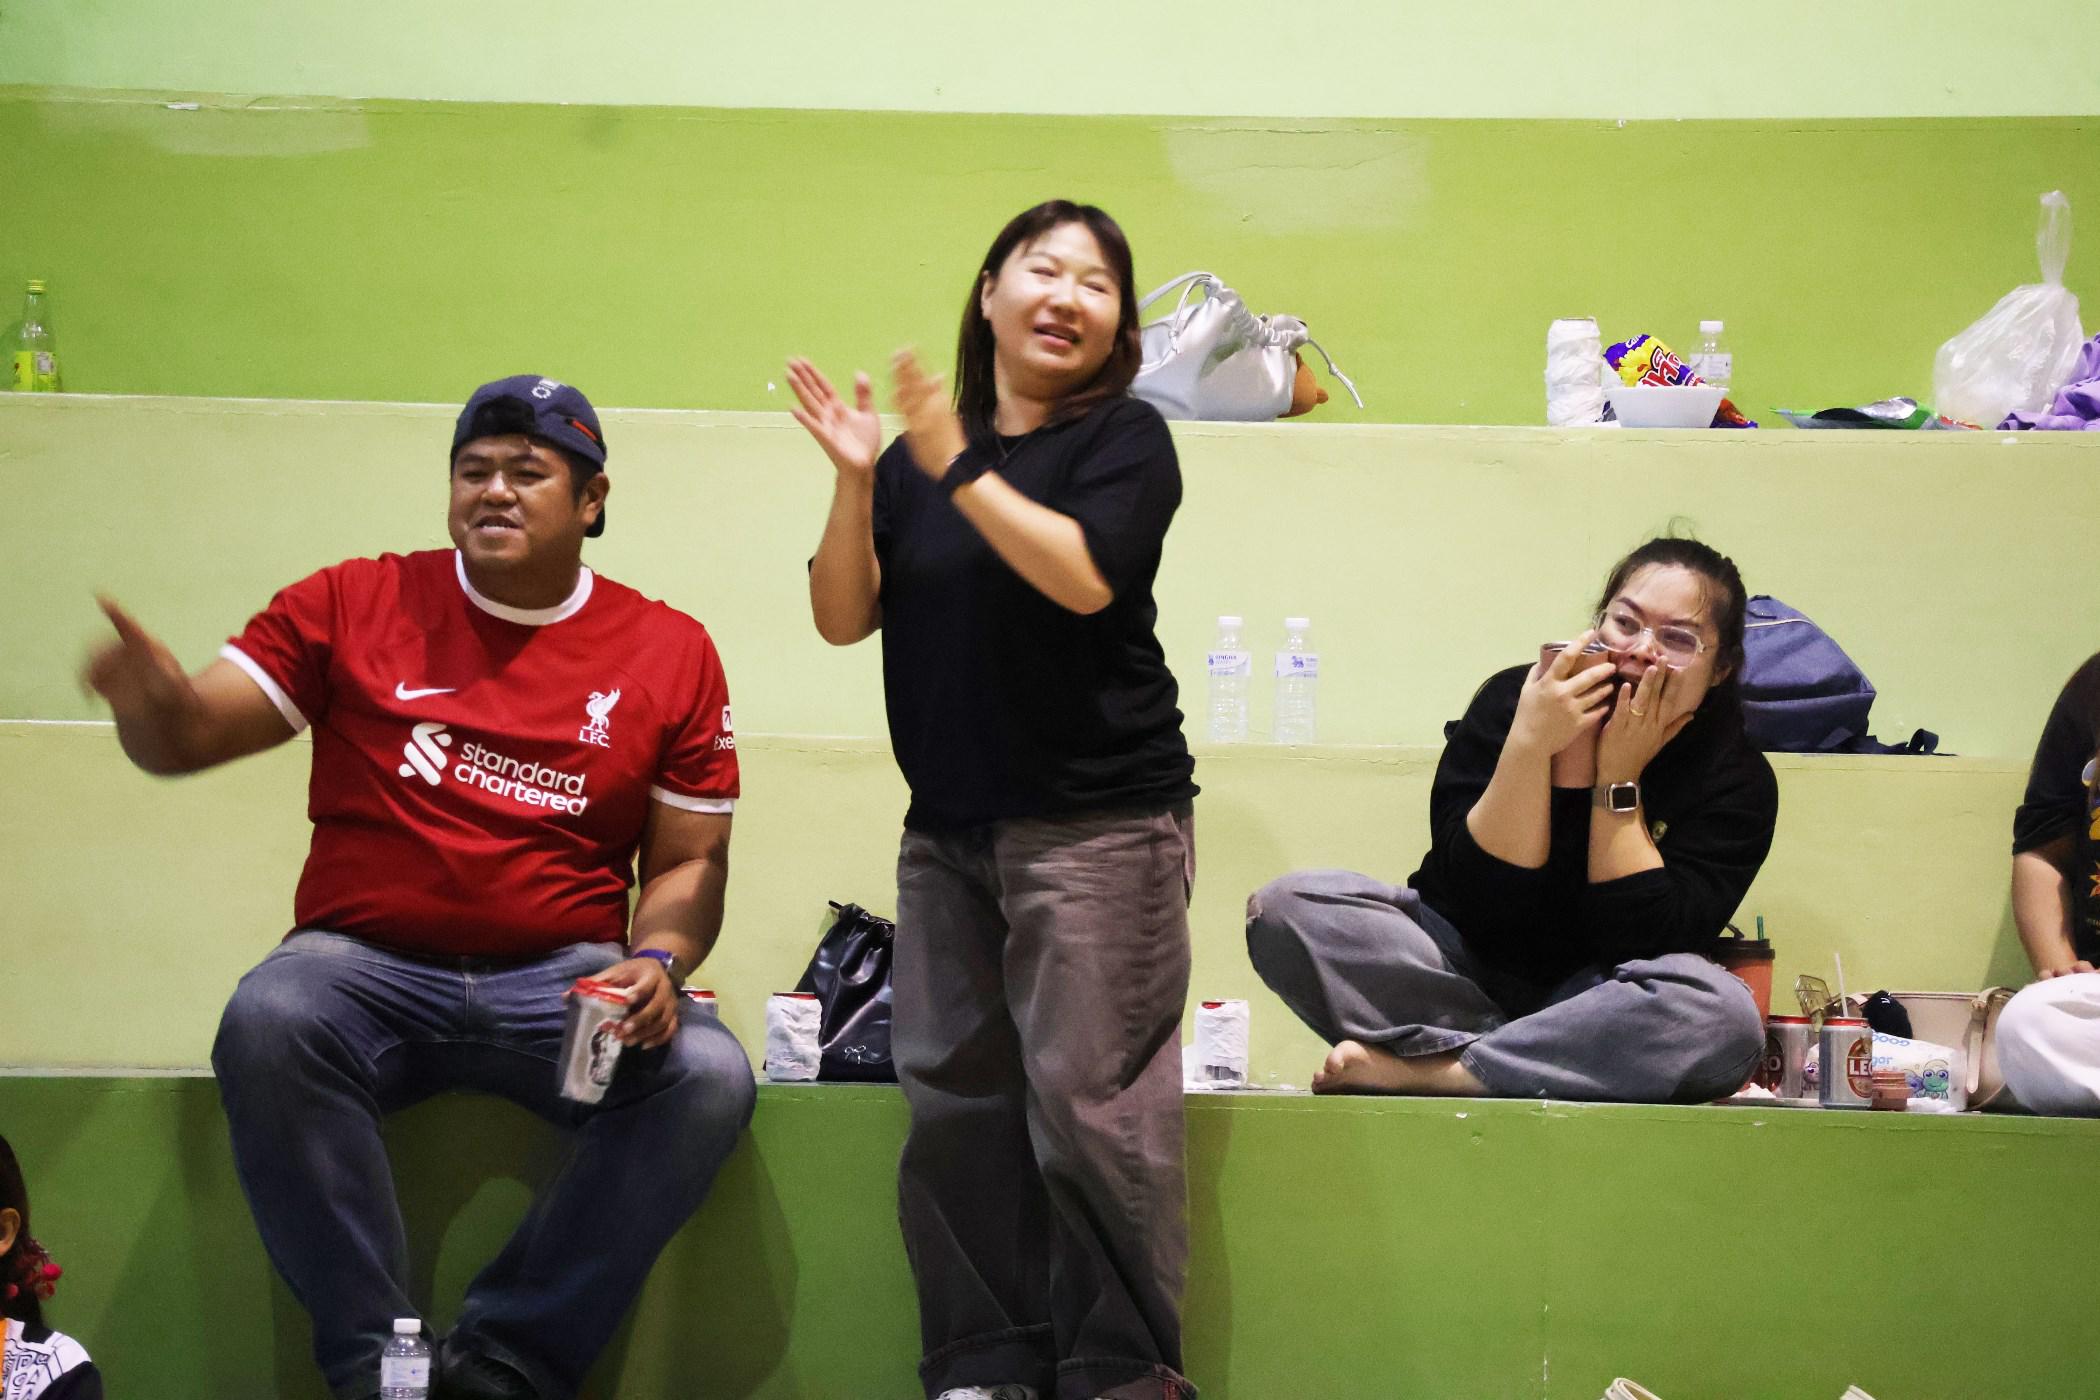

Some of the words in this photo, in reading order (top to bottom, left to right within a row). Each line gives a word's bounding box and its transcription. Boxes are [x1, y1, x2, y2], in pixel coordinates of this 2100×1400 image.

[579, 729, 611, 748] LFC
[454, 763, 588, 816] chartered
[460, 742, 586, 796] standard
